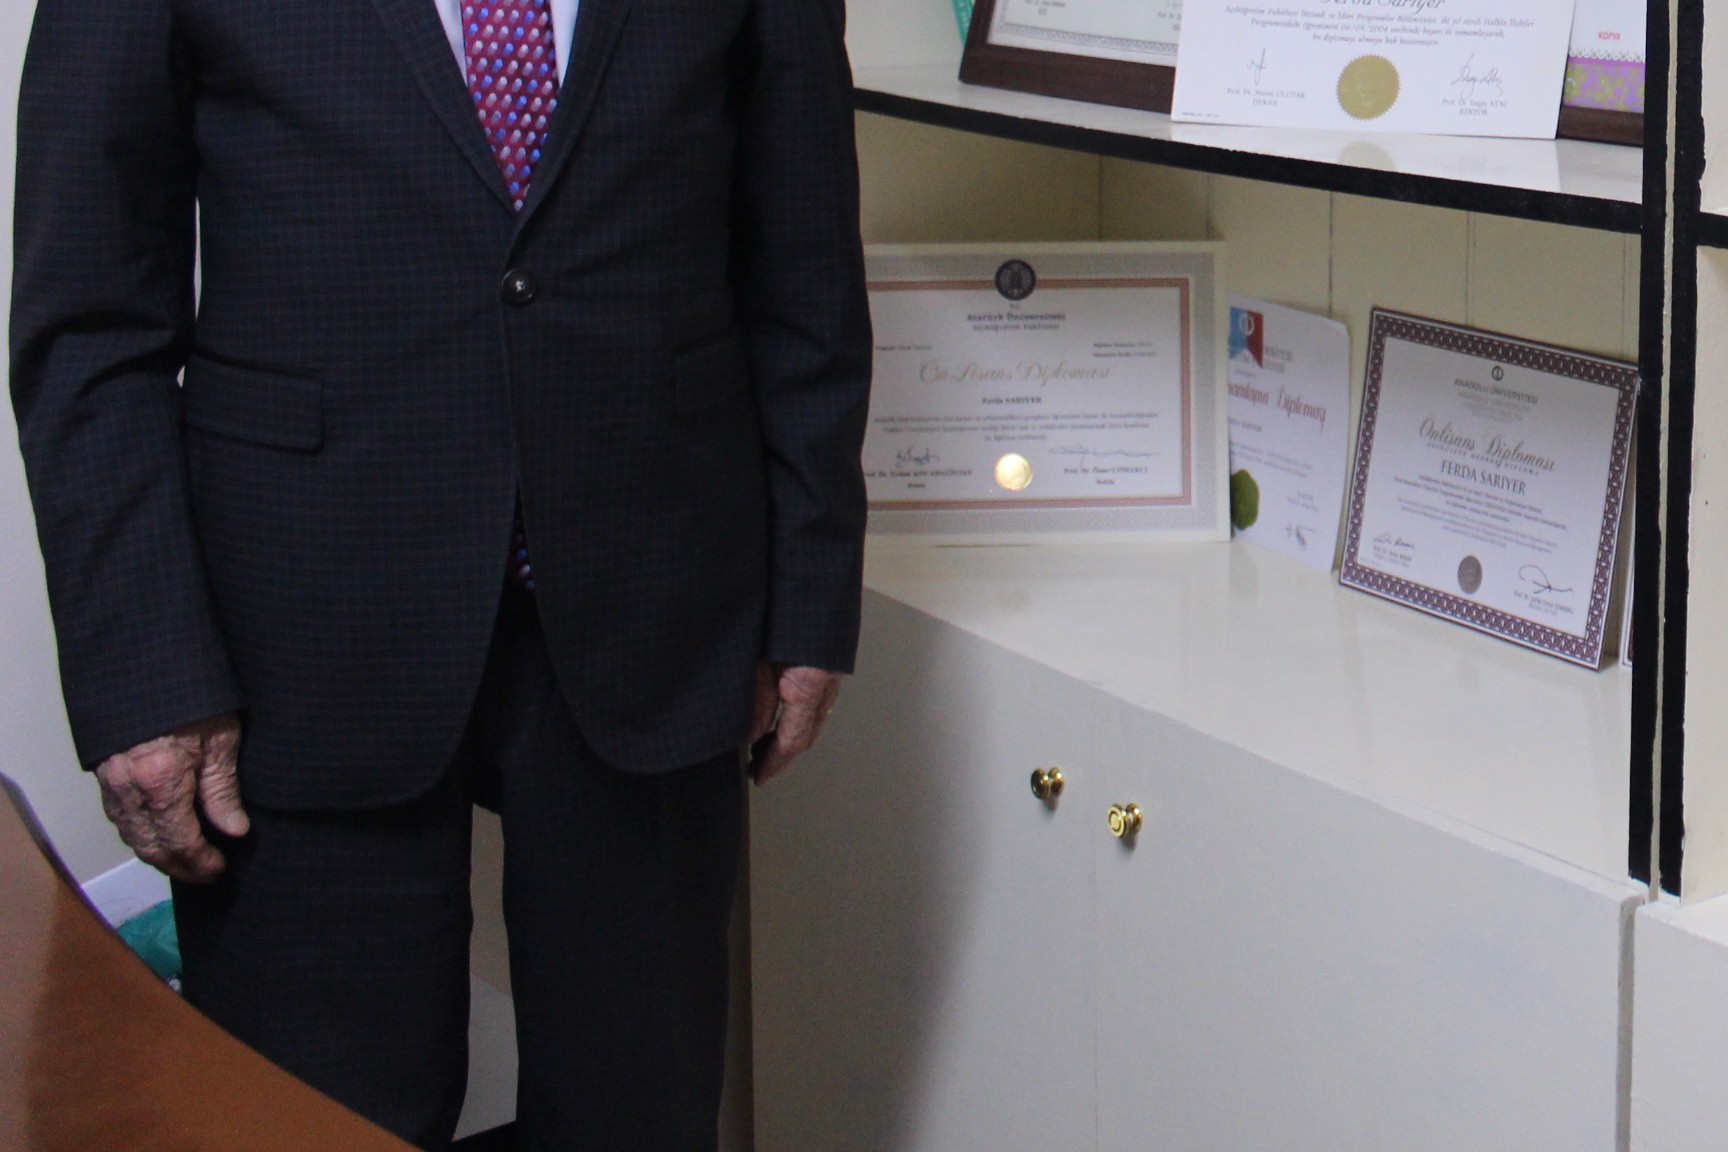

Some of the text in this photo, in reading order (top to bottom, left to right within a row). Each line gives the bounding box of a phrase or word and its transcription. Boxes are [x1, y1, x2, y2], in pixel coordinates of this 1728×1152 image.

[1598, 32, 1621, 41] KOPYA
[1441, 460, 1526, 495] FERDA SARIYER
